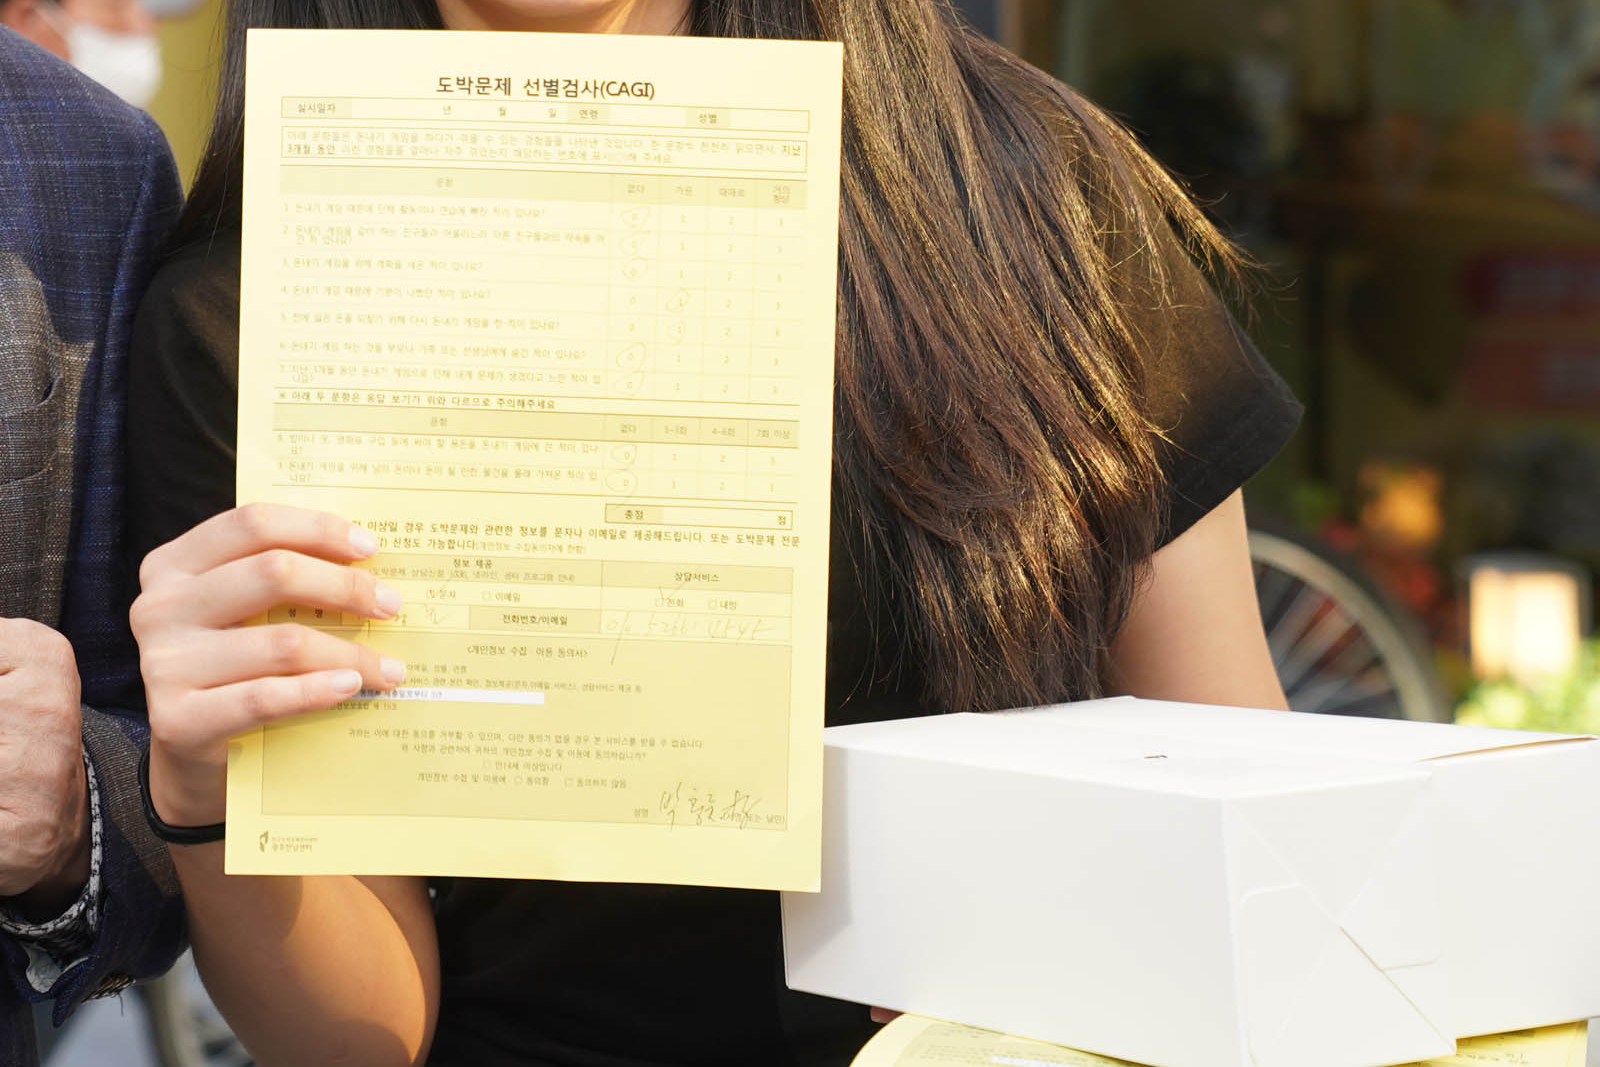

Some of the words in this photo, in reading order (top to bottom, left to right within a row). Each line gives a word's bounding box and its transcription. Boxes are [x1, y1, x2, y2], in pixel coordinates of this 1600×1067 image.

[437, 74, 511, 97] 도박문제
[524, 76, 654, 101] 선별검사(CAGI)
[297, 101, 335, 113] 실시일자
[442, 104, 452, 115] 년
[498, 105, 506, 117] 월
[548, 107, 556, 118] 일
[698, 113, 720, 124] 성별
[624, 509, 643, 520] 총점
[777, 515, 786, 526] 점
[367, 520, 398, 533] 이상일
[404, 521, 423, 534] 경우
[430, 522, 478, 536] 도박문제와
[484, 524, 513, 537] 관련한
[519, 525, 547, 538] 정보를
[554, 526, 582, 539] 문자나
[588, 527, 626, 541] 이메일로
[633, 529, 704, 544] 제공해드립니다.
[709, 532, 729, 545] 또는
[736, 533, 775, 547] 도박문제
[781, 535, 799, 548] 전문
[452, 557, 470, 569] 정보
[474, 558, 492, 569] 제공
[495, 591, 520, 602] 이메일
[502, 612, 567, 626] 전화번호/이메일
